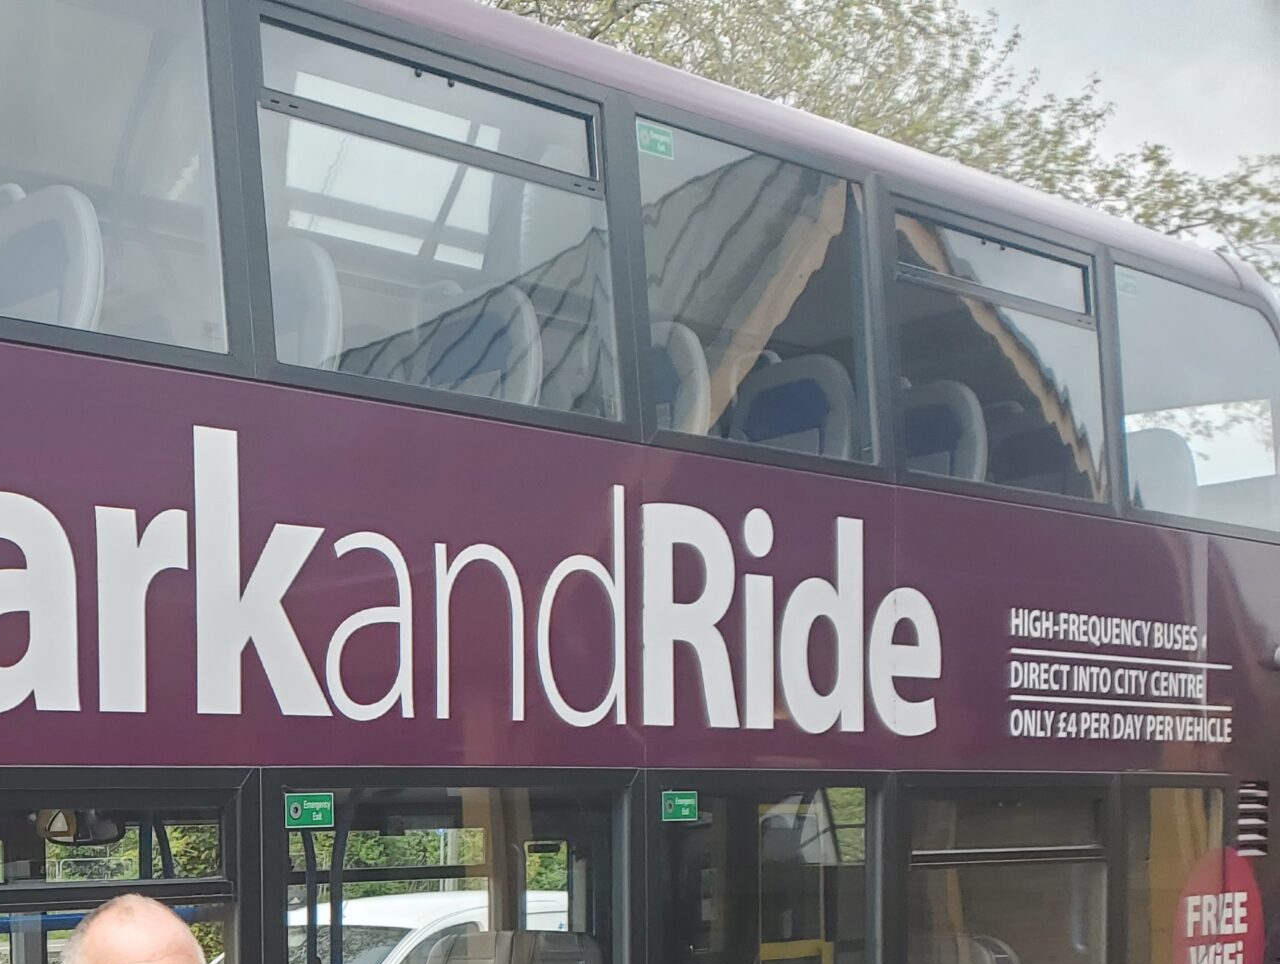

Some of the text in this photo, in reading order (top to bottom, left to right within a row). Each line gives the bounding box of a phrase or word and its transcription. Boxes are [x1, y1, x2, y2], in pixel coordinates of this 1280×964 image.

[1010, 607, 1153, 647] HIGH-FREQUENCY
[1010, 661, 1204, 699] DIRECT INTO CITY CENTRE
[1010, 708, 1232, 743] ONLY £4 PER DAY PER VEHICLE
[1186, 892, 1248, 938] FREE
